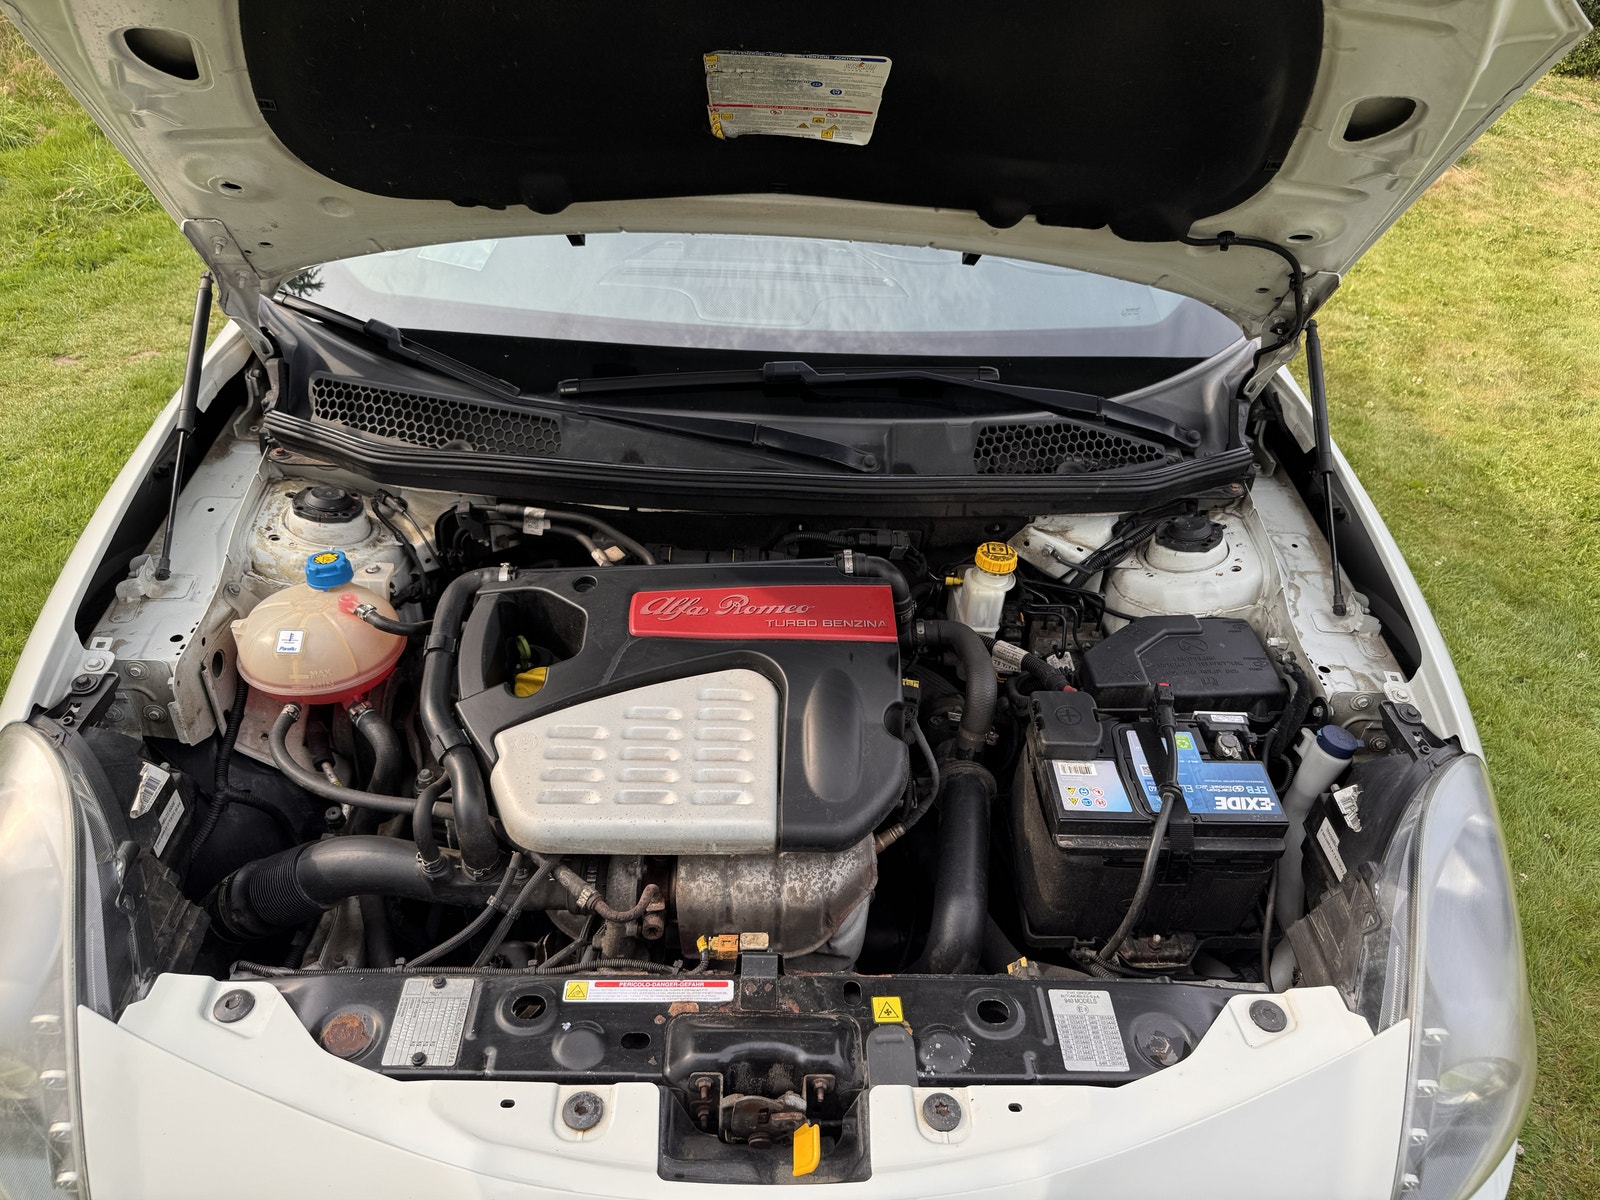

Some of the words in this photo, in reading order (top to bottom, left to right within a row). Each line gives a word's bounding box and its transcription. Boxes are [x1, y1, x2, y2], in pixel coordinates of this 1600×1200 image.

[640, 596, 710, 621] Alfa
[715, 594, 815, 616] Romeo
[765, 619, 818, 628] TURBO
[822, 619, 888, 629] BENZINA
[1246, 785, 1269, 795] EFB
[1214, 796, 1273, 811] EXIDE
